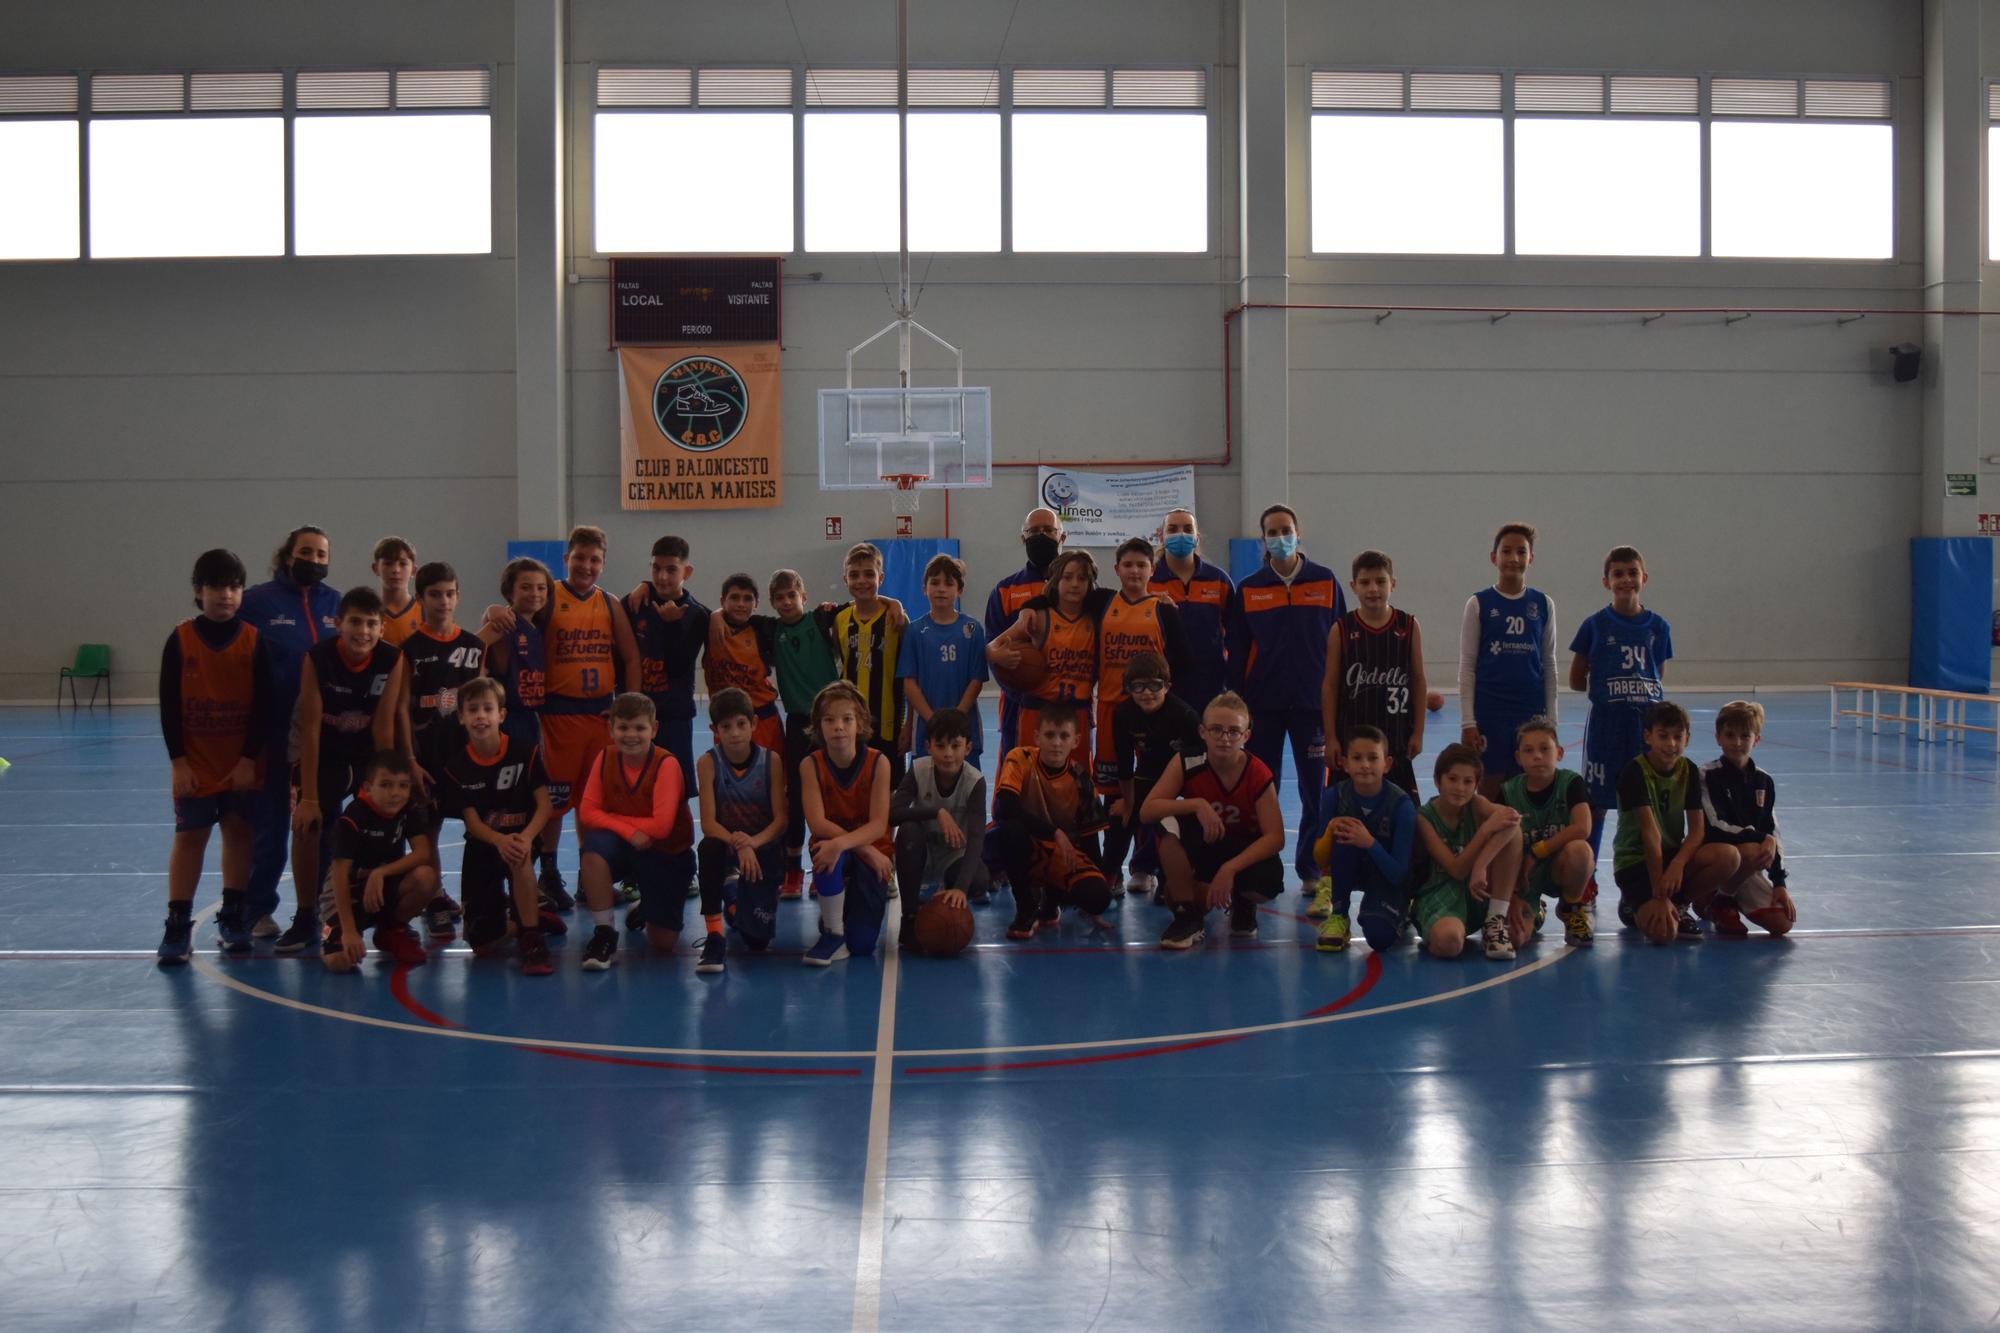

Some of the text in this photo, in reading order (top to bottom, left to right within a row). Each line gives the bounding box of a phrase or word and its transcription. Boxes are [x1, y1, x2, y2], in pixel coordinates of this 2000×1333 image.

[618, 282, 640, 290] FALTAS
[751, 281, 773, 289] FALTAS
[622, 294, 664, 306] LOCAL
[728, 294, 770, 305] VISITANTE
[670, 360, 729, 380] MANISES
[635, 456, 769, 477] CLUB BALONCESTO
[628, 480, 776, 500] CERAMICA MANISES
[1505, 615, 1525, 635] 20
[1104, 632, 1148, 646] Cultura
[448, 646, 482, 669] 40
[939, 644, 957, 662] 36
[1620, 645, 1646, 670] 34
[1346, 662, 1409, 699] Godella
[1606, 681, 1662, 697] TABERNES
[1386, 687, 1410, 714] 32
[496, 762, 525, 790] 81
[1586, 760, 1606, 786] 34
